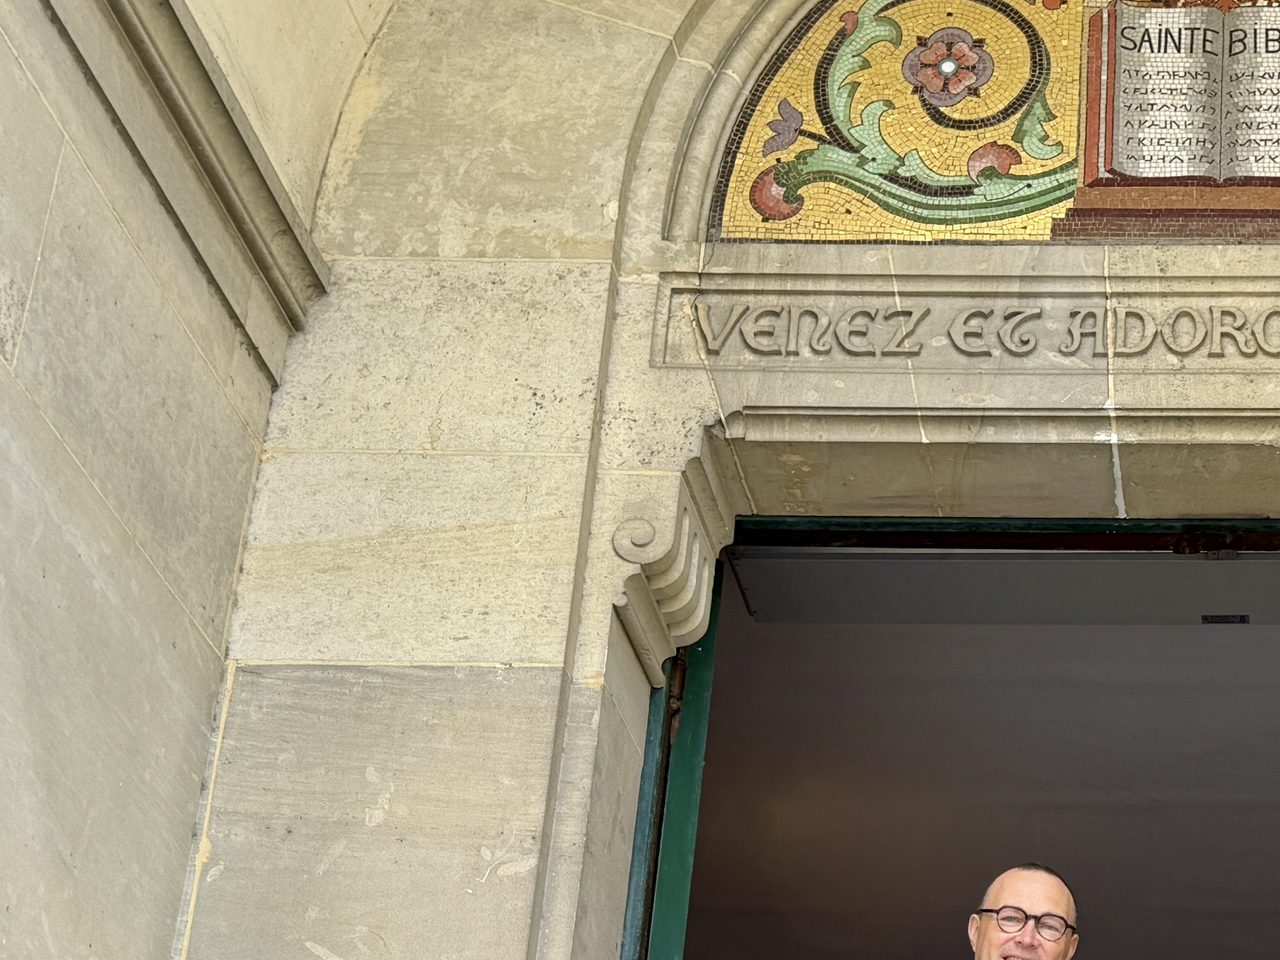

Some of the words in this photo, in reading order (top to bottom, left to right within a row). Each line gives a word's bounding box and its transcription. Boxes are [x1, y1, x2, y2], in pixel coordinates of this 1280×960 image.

[1120, 23, 1220, 56] SAINTE
[693, 302, 931, 358] VENEZ
[947, 305, 1042, 358] ET
